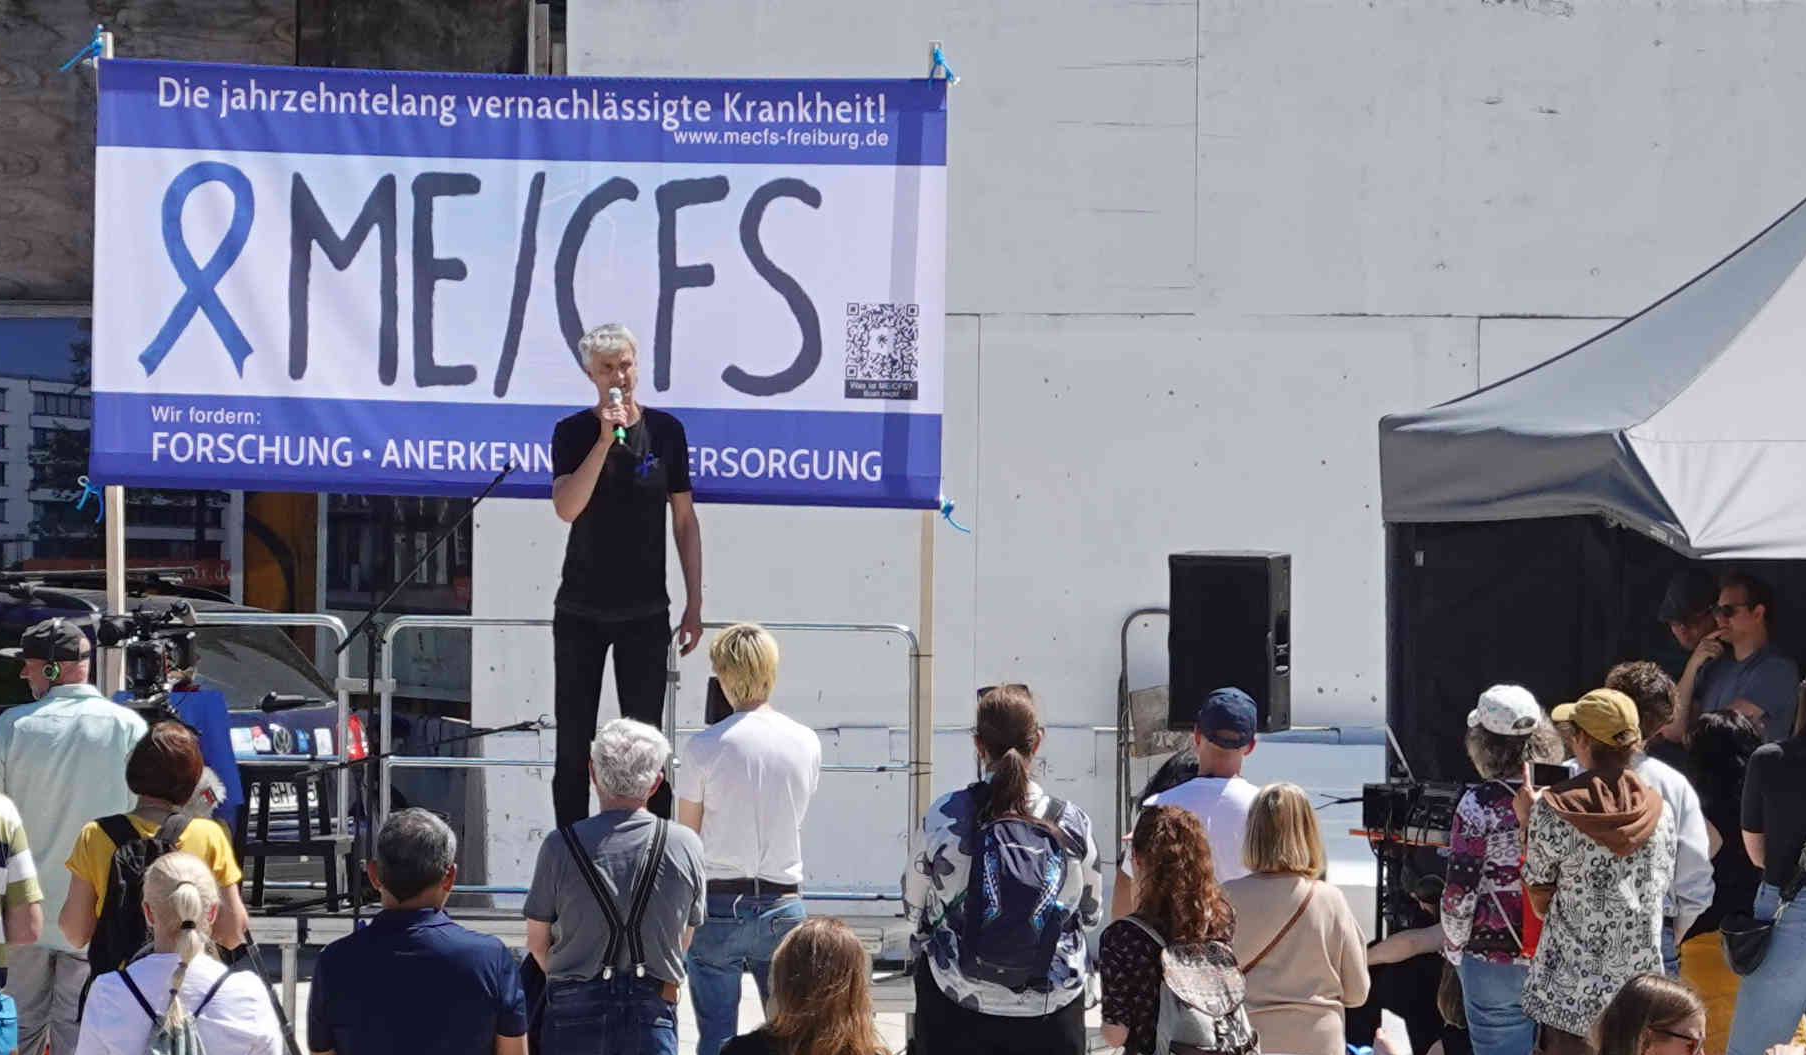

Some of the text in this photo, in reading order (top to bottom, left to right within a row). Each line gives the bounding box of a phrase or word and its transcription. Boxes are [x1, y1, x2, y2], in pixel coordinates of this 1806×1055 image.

[158, 76, 887, 131] Die jahrzehntelang vernachlässigte Krankheit!
[674, 127, 889, 150] www.mecfs-freiburg.de
[288, 171, 824, 398] ME/CFS
[151, 405, 261, 425] Wir fordern:
[151, 431, 883, 482] FORSCHUNG ANERKENN ERSORGUNG
